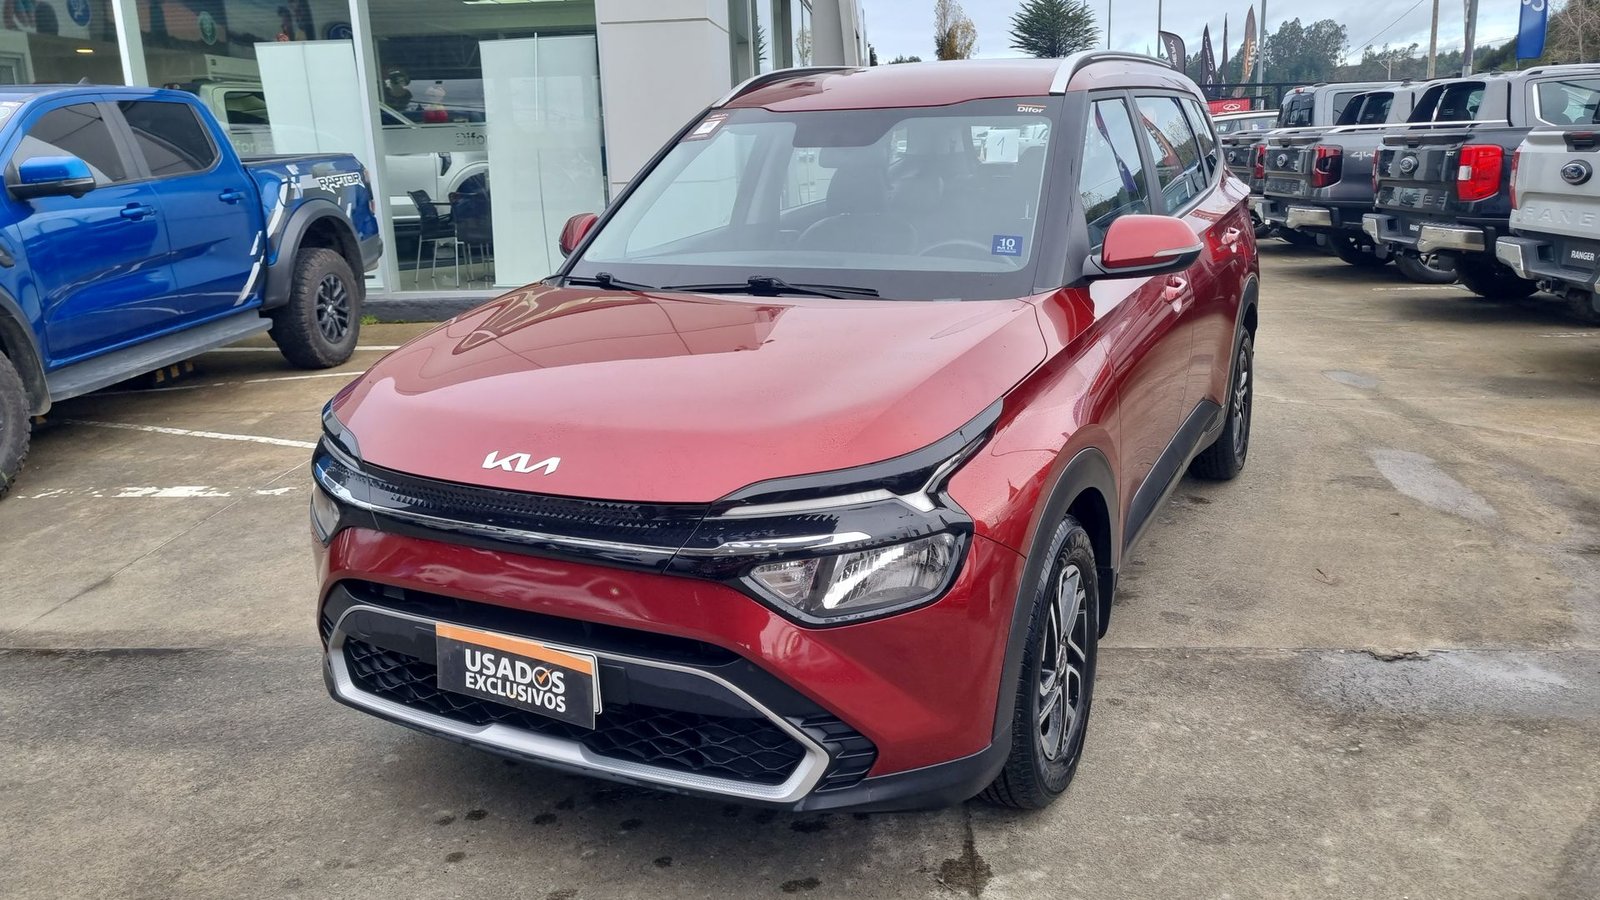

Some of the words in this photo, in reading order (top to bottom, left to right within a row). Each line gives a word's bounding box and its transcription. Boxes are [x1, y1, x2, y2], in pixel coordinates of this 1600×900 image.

[456, 132, 487, 146] Difo
[316, 172, 365, 194] RAPTOR
[1000, 237, 1016, 247] 10
[1571, 250, 1595, 261] RANGER
[465, 648, 566, 695] USADOS
[465, 671, 567, 713] EXCLUSIVOS
